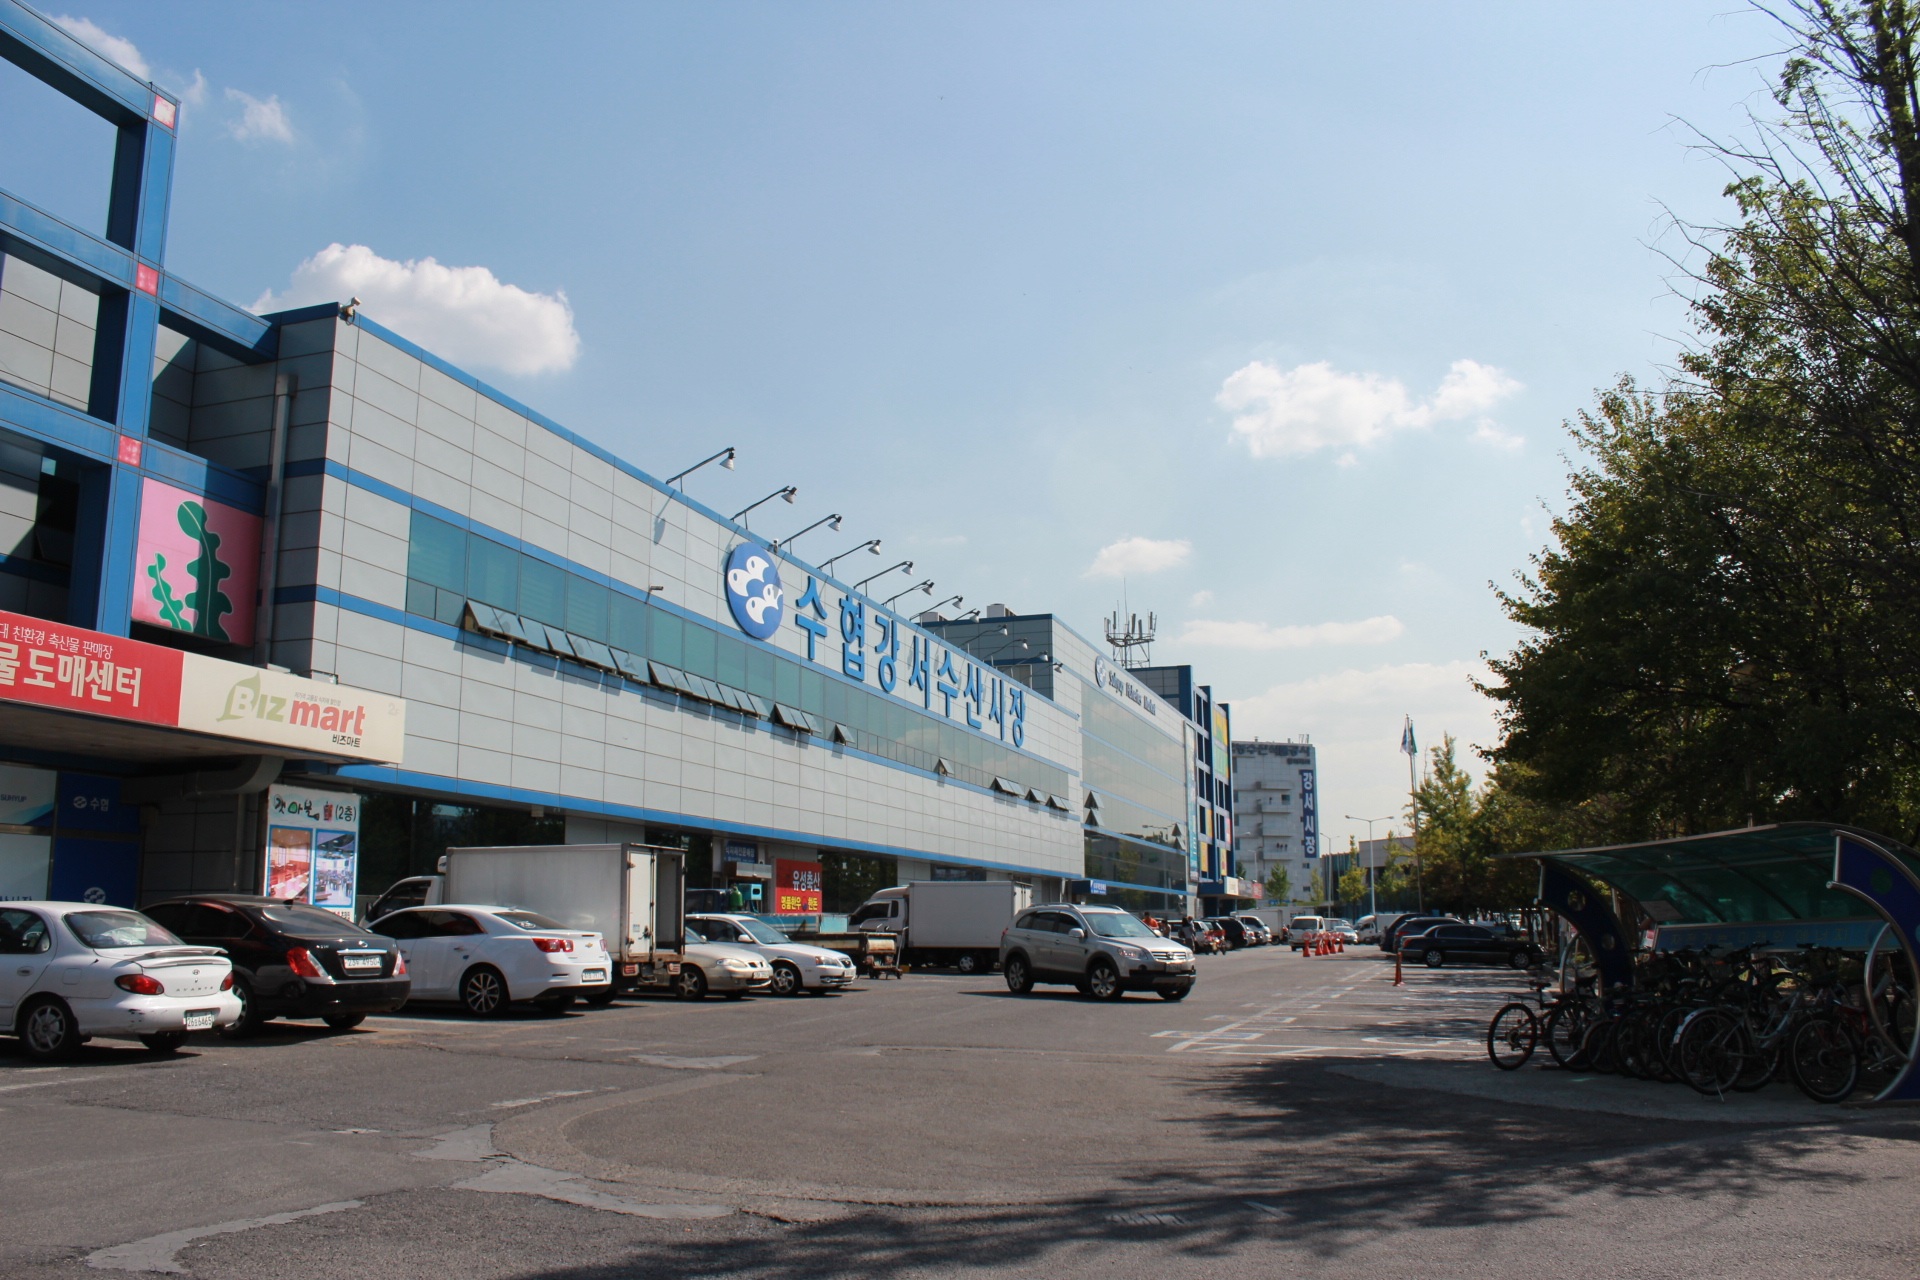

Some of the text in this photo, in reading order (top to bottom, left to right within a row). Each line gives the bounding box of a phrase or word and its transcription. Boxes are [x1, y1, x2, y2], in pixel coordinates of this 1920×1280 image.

[12, 626, 45, 646] 친환경
[48, 633, 80, 653] 축산물
[82, 640, 113, 660] 판매장
[289, 699, 366, 736] mart
[332, 734, 361, 748] 비즈마트
[90, 798, 110, 812] 수협
[793, 870, 820, 892] 유성축산
